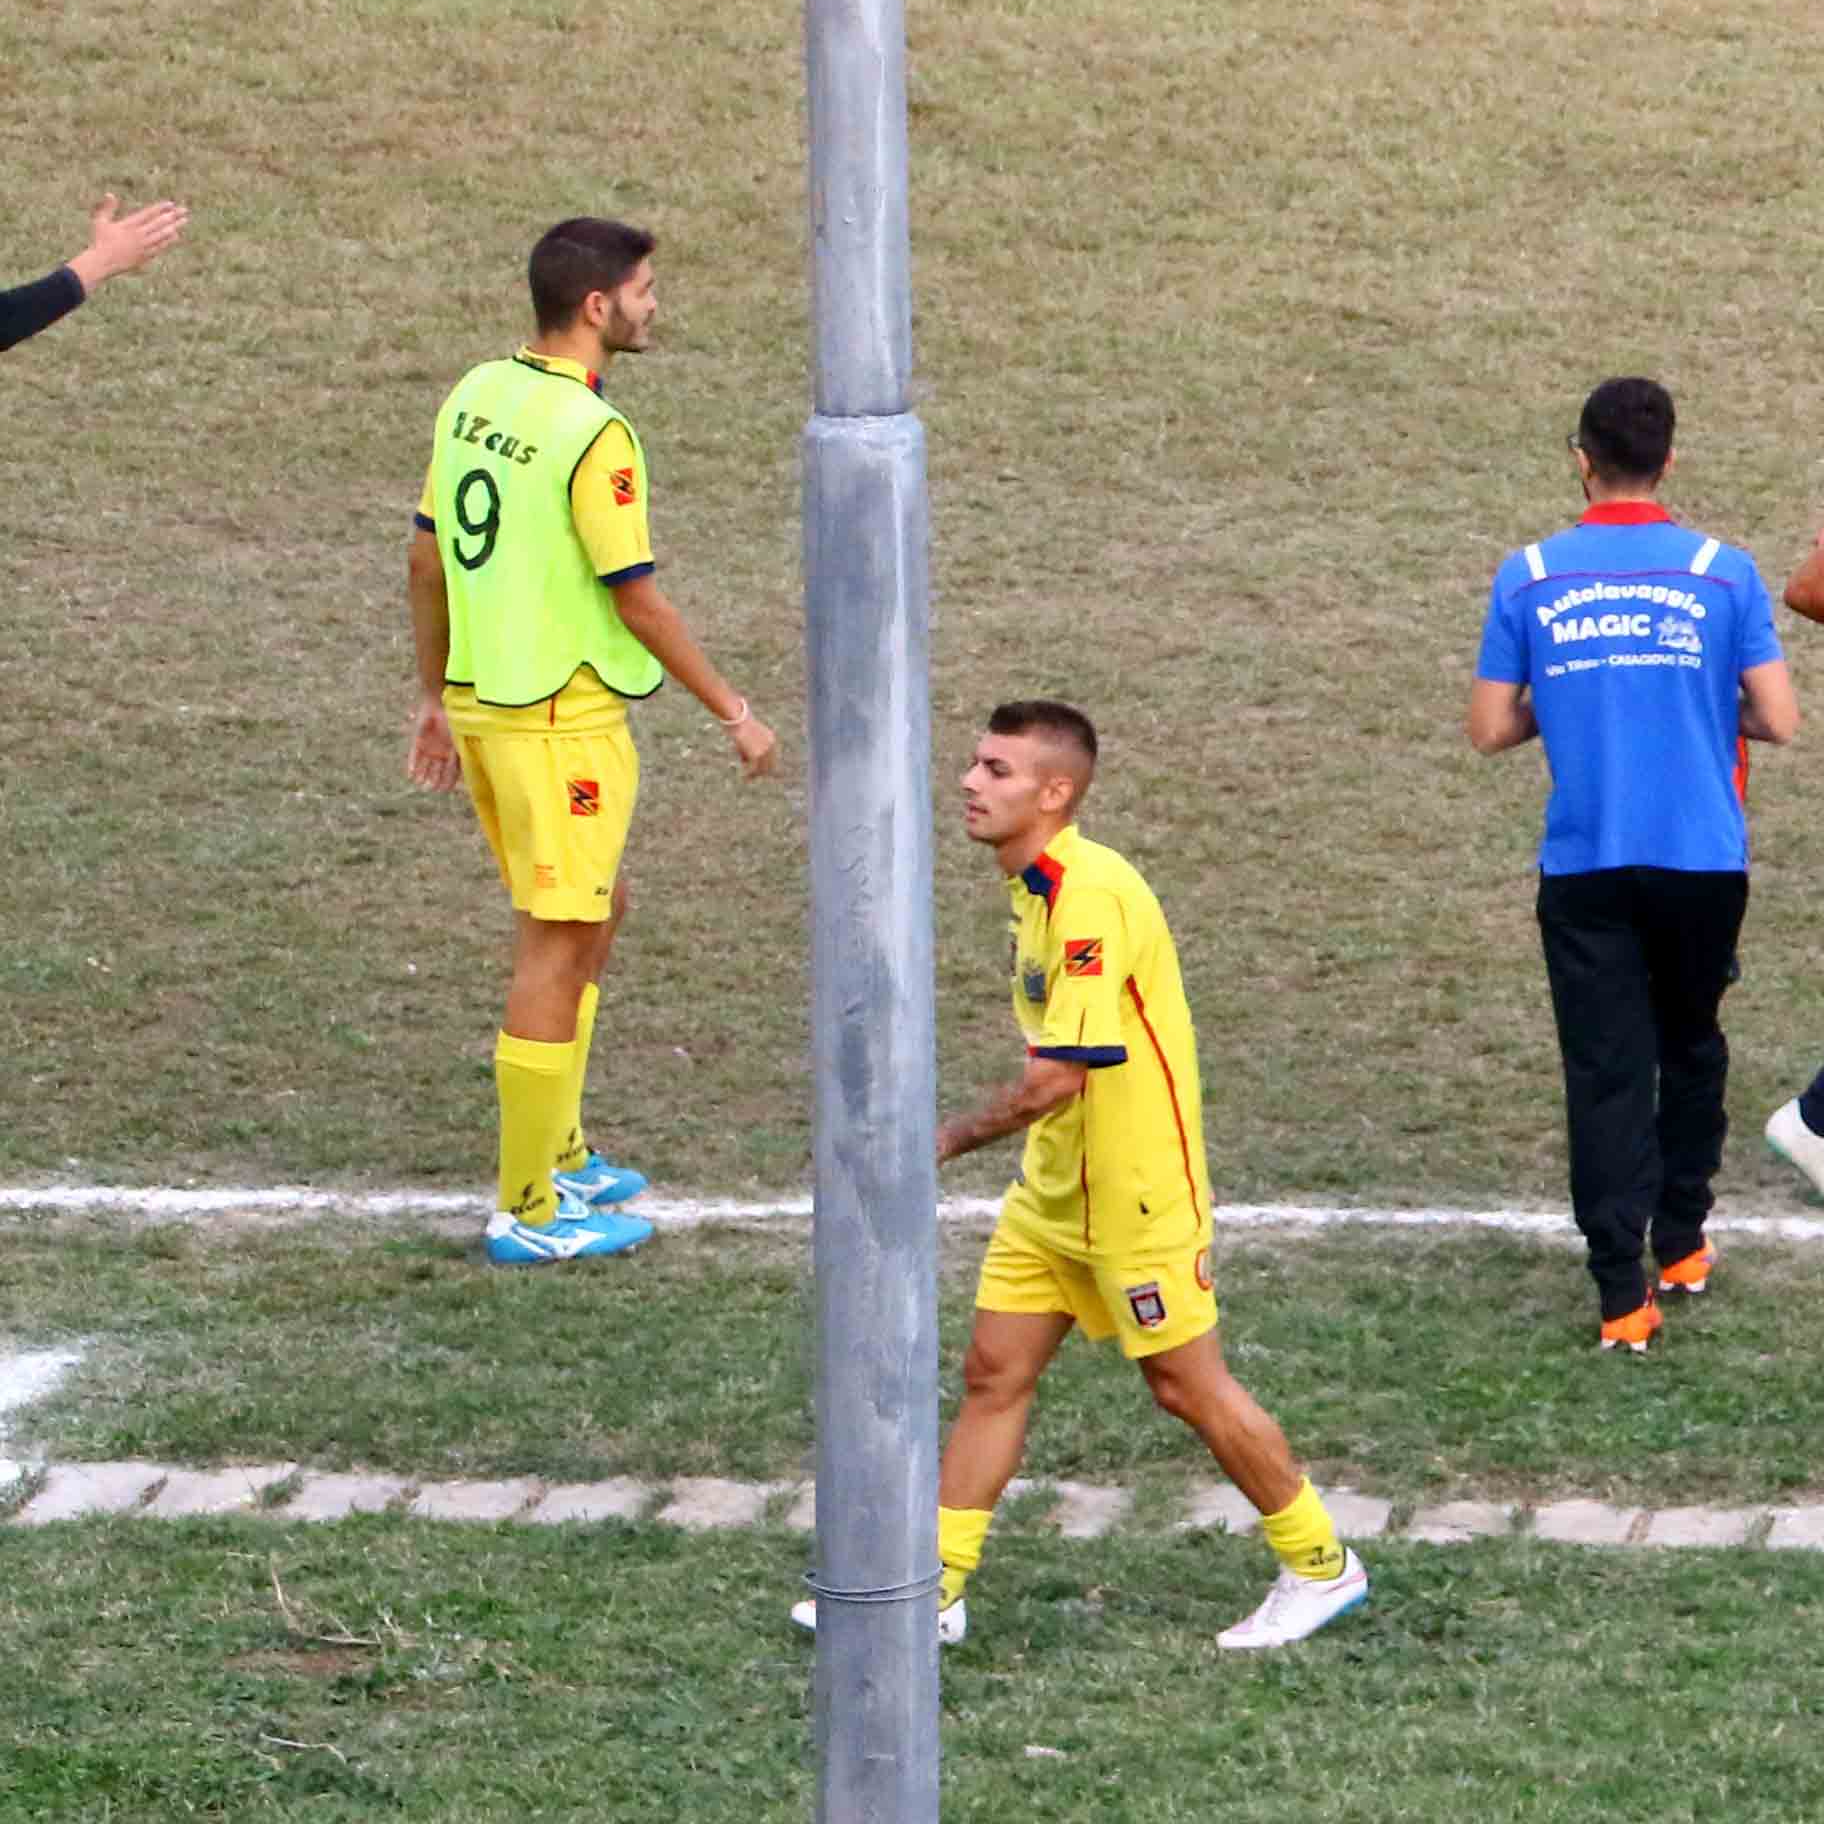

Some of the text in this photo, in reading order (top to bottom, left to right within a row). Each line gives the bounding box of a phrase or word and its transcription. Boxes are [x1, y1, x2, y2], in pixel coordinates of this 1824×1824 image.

[452, 468, 501, 571] 9
[1536, 582, 1707, 626] Autolavaggio
[1552, 614, 1651, 644] MAGIC
